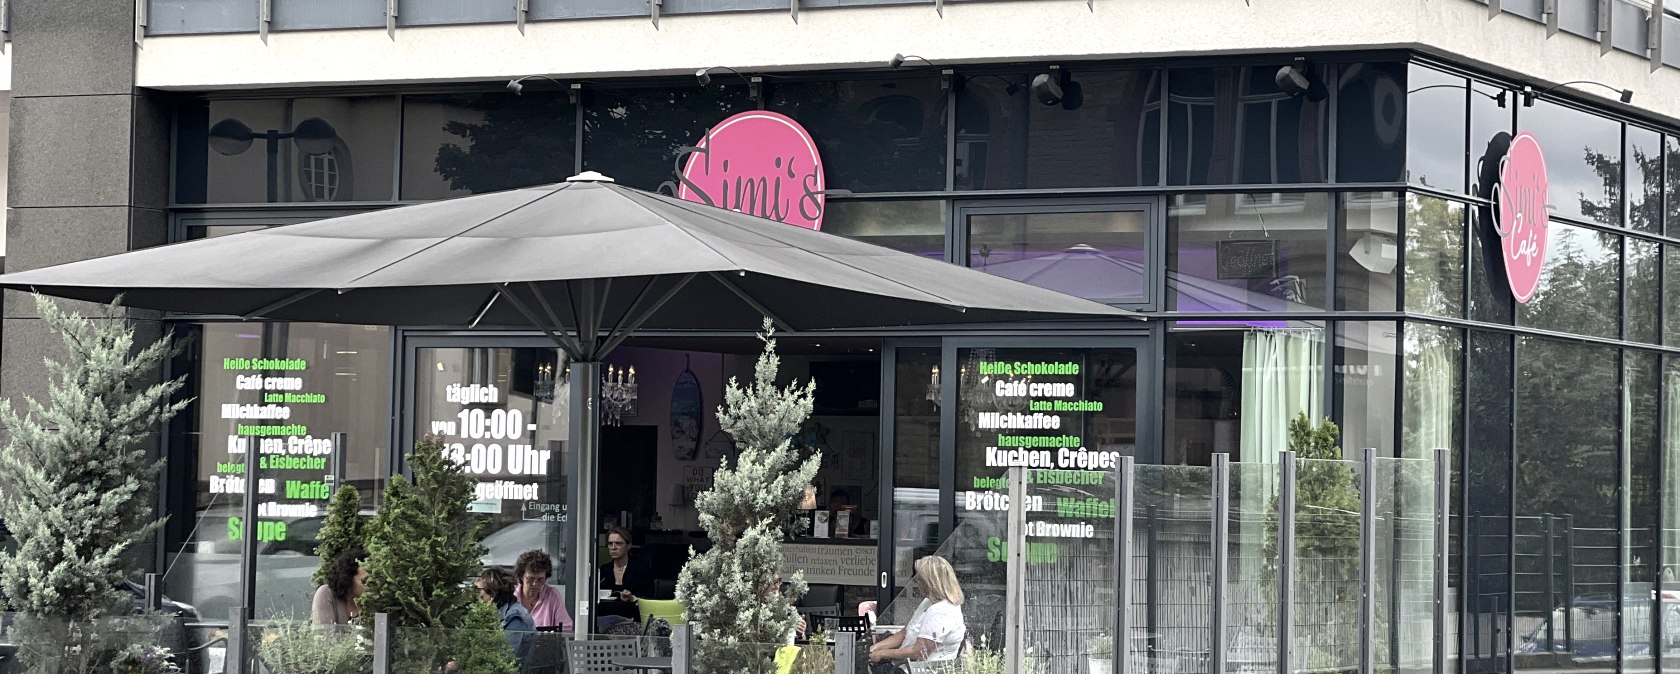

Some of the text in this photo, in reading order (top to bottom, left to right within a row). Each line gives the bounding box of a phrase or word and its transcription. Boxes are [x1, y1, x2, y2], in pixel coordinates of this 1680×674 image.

[1511, 213, 1538, 267] Café
[252, 358, 306, 370] Schokolade
[979, 362, 1080, 375] Heiße Schokolade
[236, 374, 303, 390] Café creme
[995, 378, 1075, 397] Café creme
[264, 393, 326, 403] Latte Macchiato
[446, 383, 499, 404] täglich
[221, 404, 290, 419] Milchkaffee
[1029, 400, 1103, 411] Latte Macchiato
[431, 420, 456, 436] von
[457, 408, 523, 440] 10:00
[978, 412, 1060, 429] Milchkaffee
[238, 424, 307, 436] hausgemachte
[227, 435, 332, 455] Kuen, Crêpe
[998, 434, 1081, 448] hausgemachte
[259, 455, 326, 470] & Eisbecher
[507, 444, 551, 475] Uhr
[986, 447, 1054, 469] Kuchen,
[217, 462, 245, 474] belegt
[209, 475, 276, 494] Bröten
[1036, 469, 1105, 485] Eisbecher
[285, 480, 330, 500] Waffe
[475, 480, 539, 501] geöffnet
[528, 501, 560, 512] Eingang
[965, 491, 1043, 511] Brötcen
[267, 502, 318, 518] Brownie
[541, 512, 555, 521] die
[1036, 520, 1094, 538] Brownie
[783, 552, 877, 566] hillen relaxen verliebe
[817, 546, 854, 556] träumen
[856, 547, 876, 555] essen
[806, 566, 836, 575] trinken
[838, 566, 876, 577] Freunde
